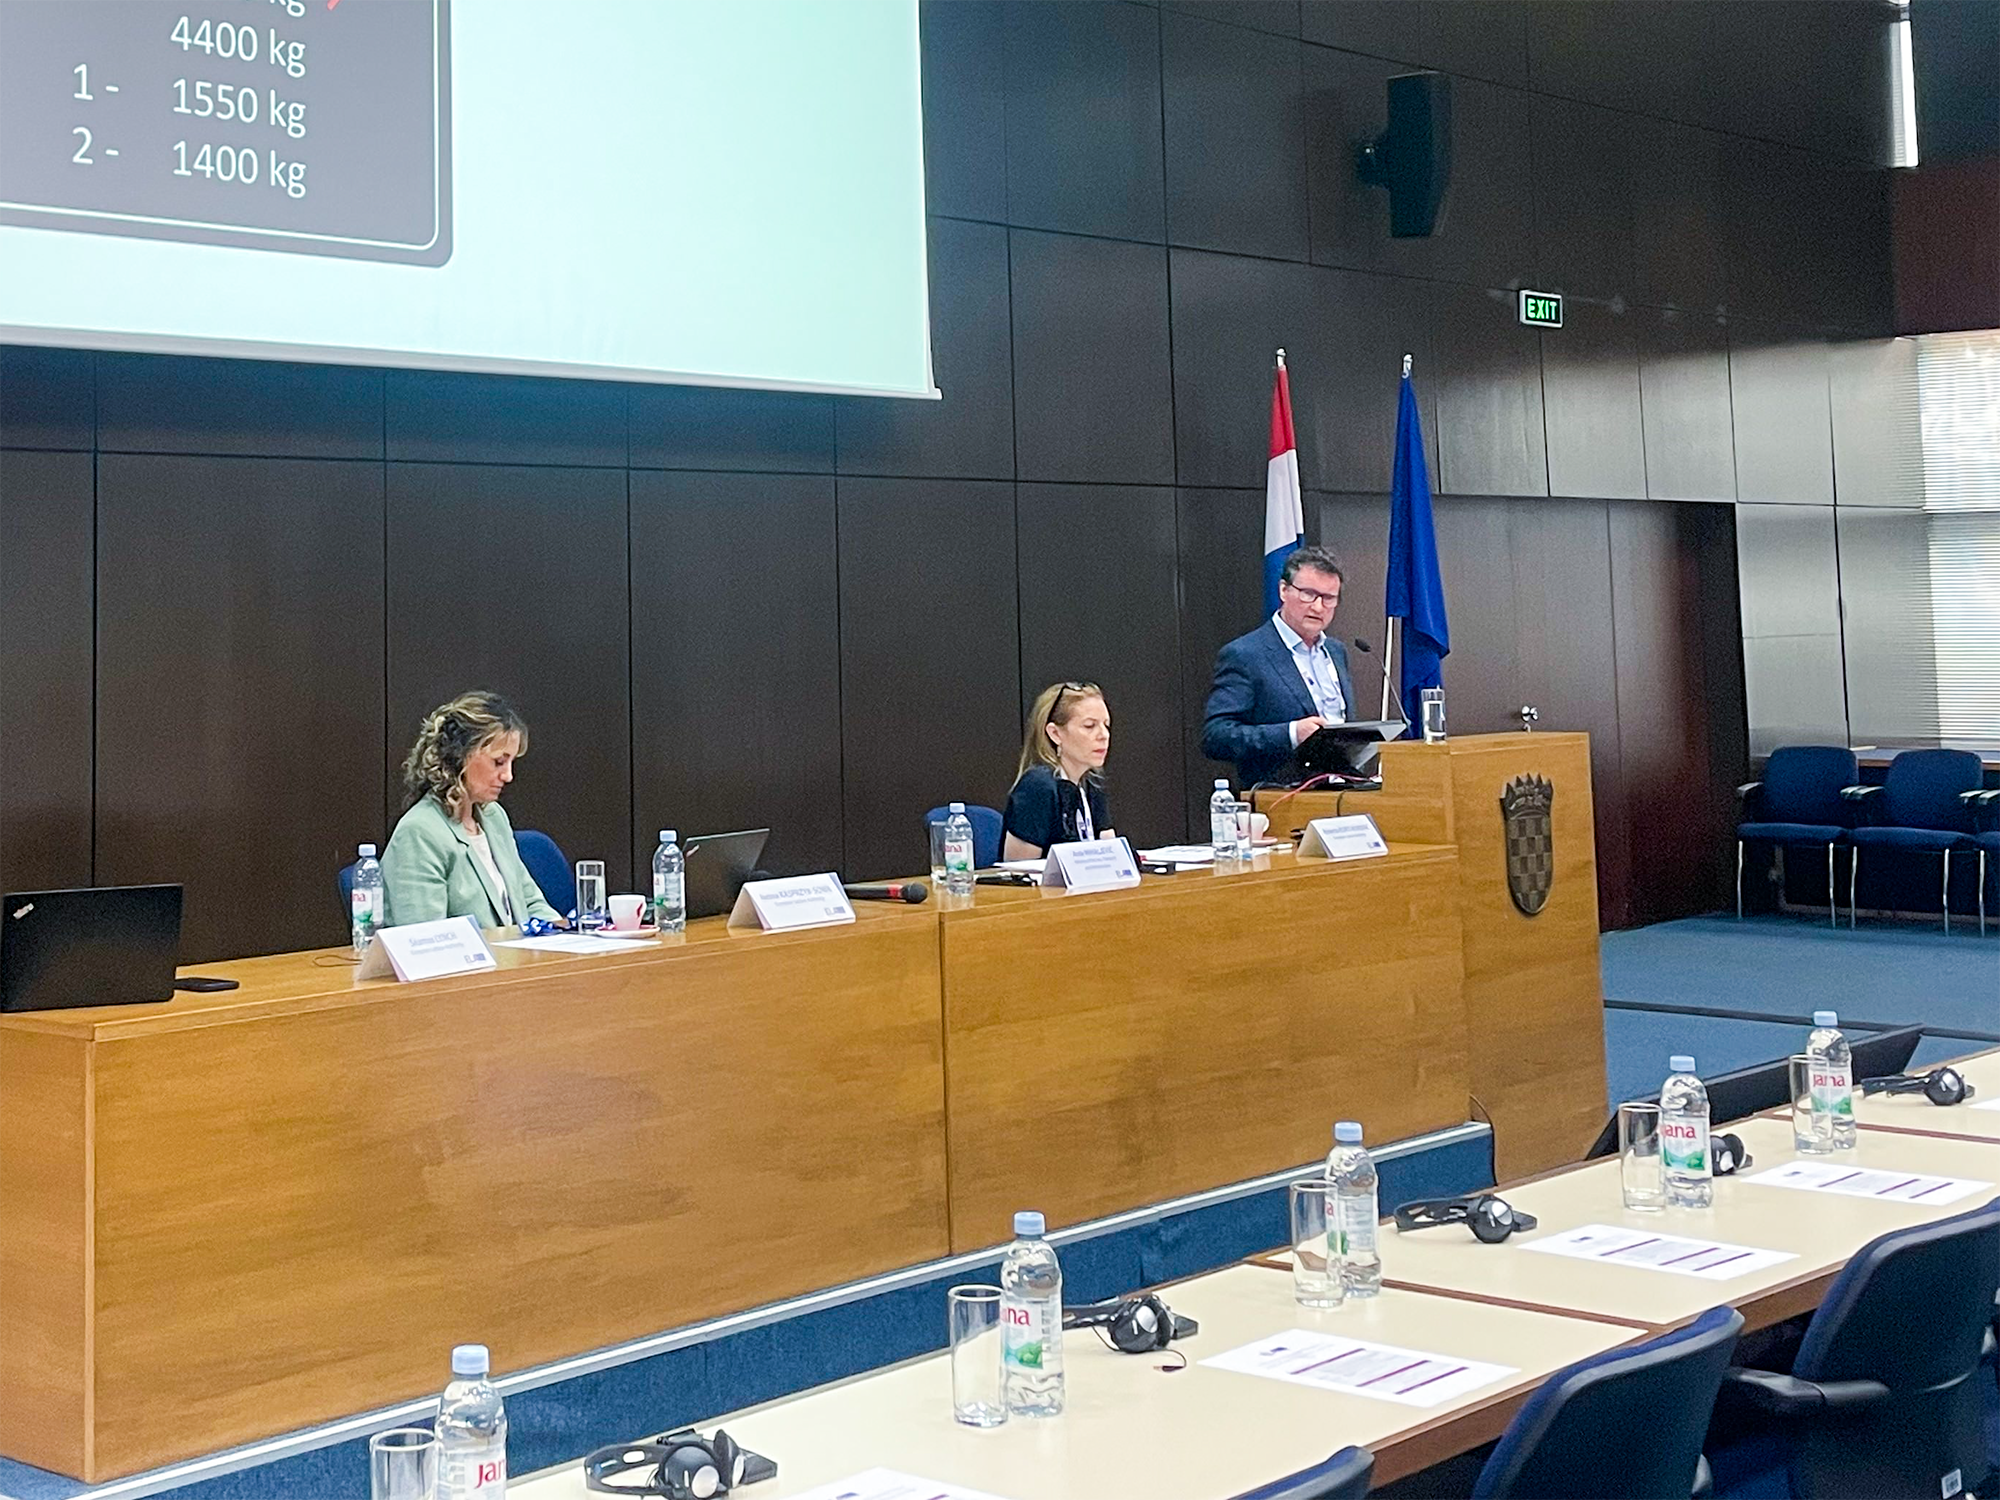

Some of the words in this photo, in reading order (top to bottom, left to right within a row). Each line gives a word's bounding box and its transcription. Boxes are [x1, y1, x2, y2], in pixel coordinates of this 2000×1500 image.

[270, 0, 305, 17] g
[170, 16, 258, 61] 4400
[270, 28, 306, 78] kg
[74, 64, 93, 100] 1
[173, 78, 258, 123] 1550
[270, 89, 306, 138] kg
[72, 127, 93, 164] 2
[173, 140, 258, 184] 1400
[270, 150, 306, 198] kg
[1527, 298, 1557, 320] EXIT
